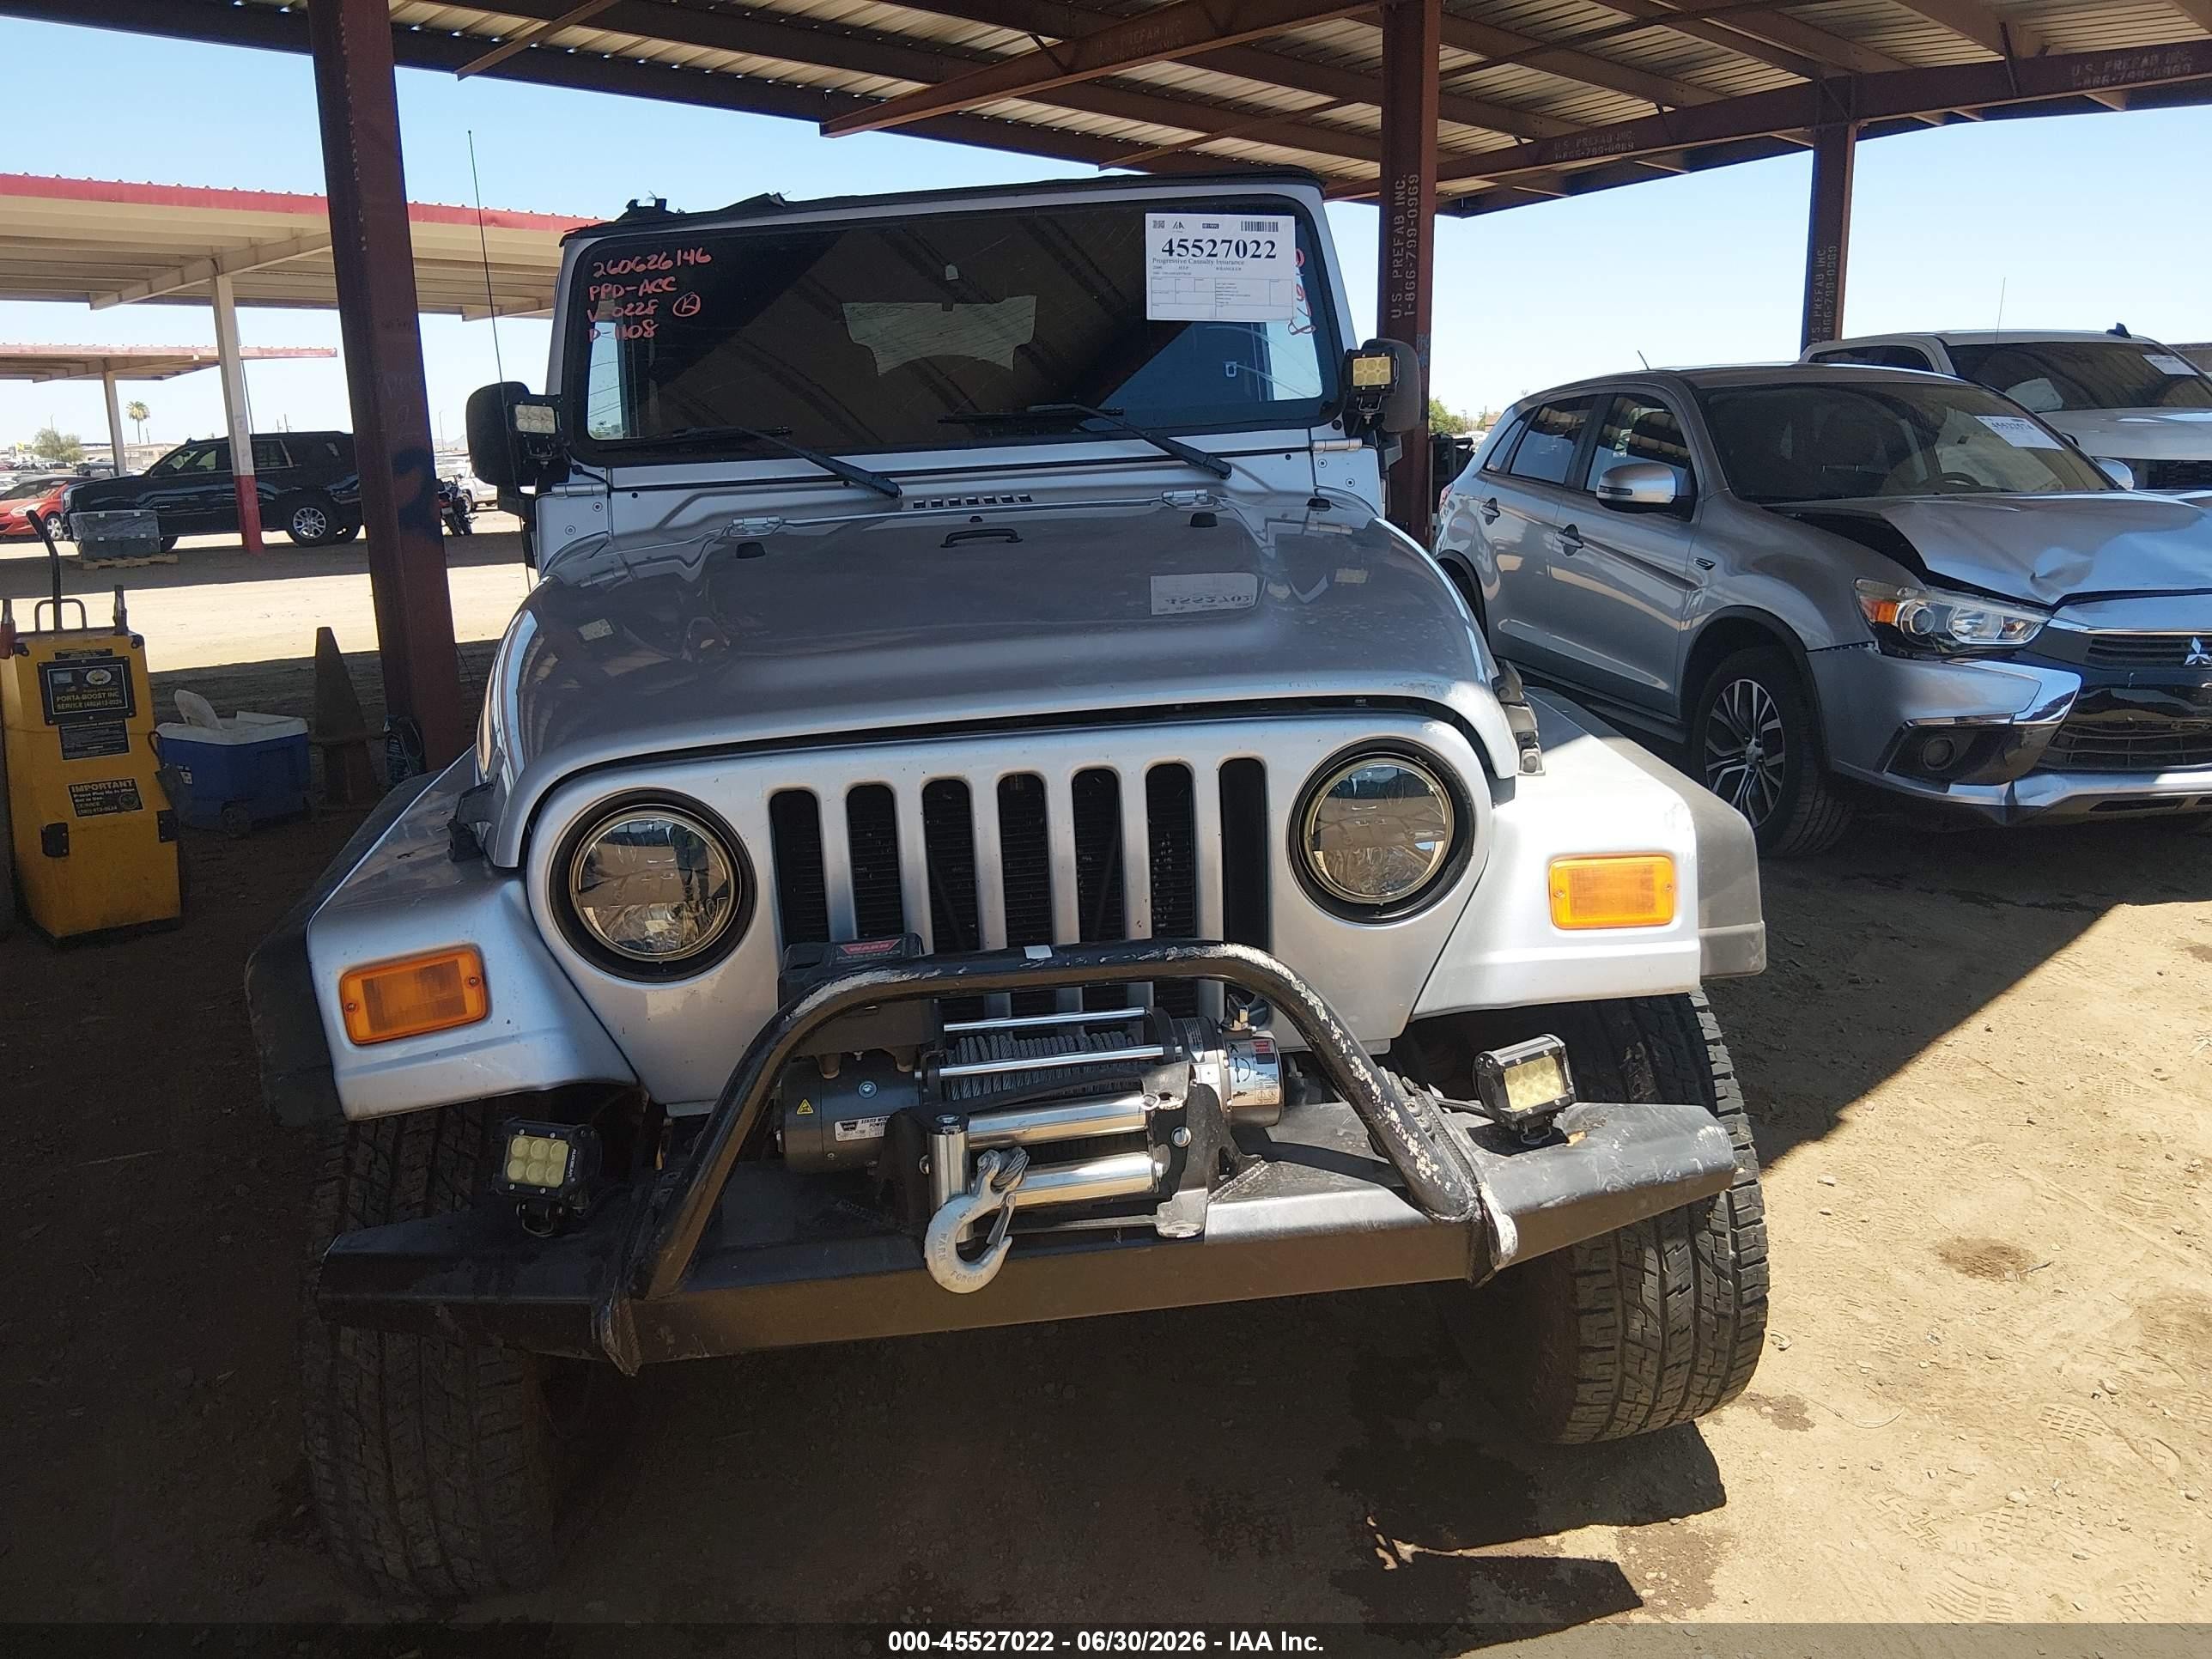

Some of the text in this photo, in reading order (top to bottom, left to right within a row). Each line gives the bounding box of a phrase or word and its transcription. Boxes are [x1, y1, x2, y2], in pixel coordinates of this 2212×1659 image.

[1395, 174, 1407, 207] INC.
[1152, 258, 1187, 266] Progressive
[1162, 238, 1277, 259] 45527022
[1393, 215, 1405, 279] PREFAB
[1404, 174, 1420, 317] 1-866-799-0969
[593, 246, 712, 279] 260626146
[588, 276, 677, 301] PPD-ACC
[1813, 273, 1825, 317] PREFAB
[71, 781, 132, 793] IMPORTANT
